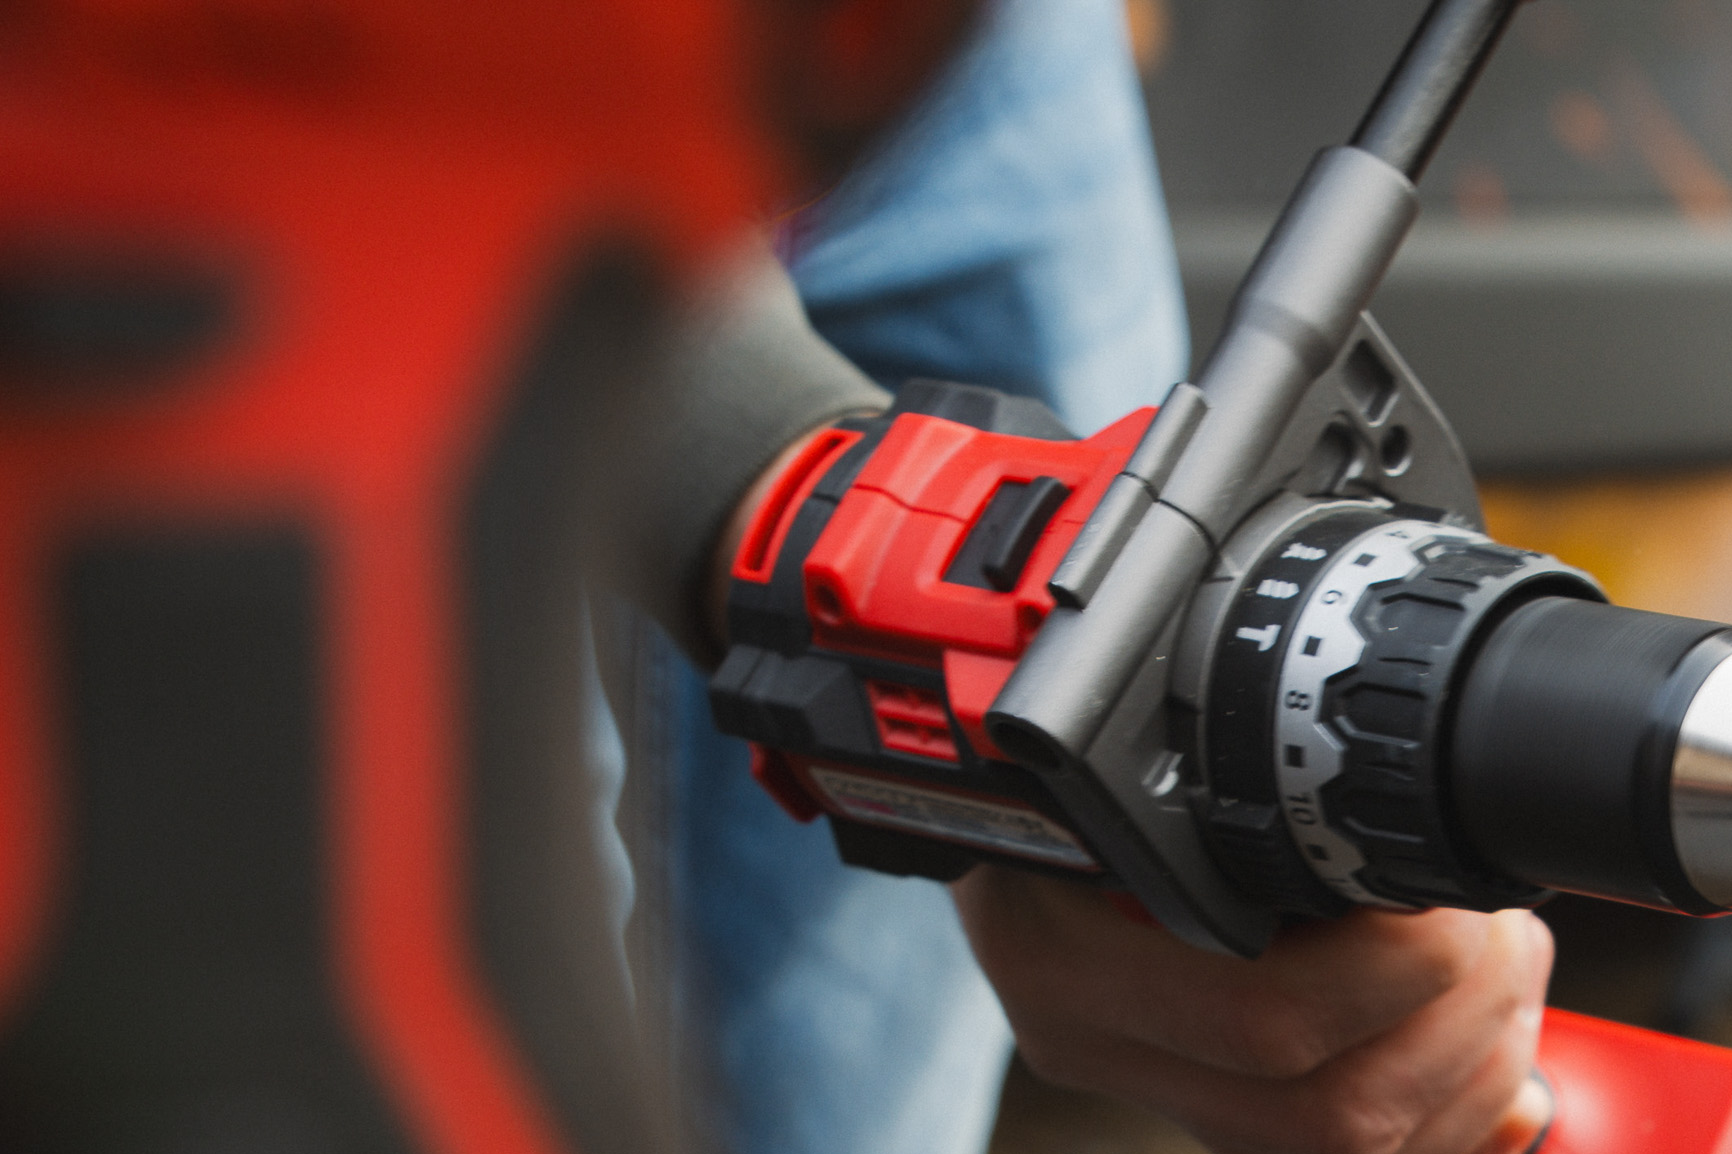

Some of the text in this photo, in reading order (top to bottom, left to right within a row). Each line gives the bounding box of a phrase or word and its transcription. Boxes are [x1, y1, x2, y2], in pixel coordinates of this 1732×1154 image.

[1320, 588, 1344, 605] 6
[1283, 688, 1312, 711] 8
[1285, 793, 1318, 826] 10
